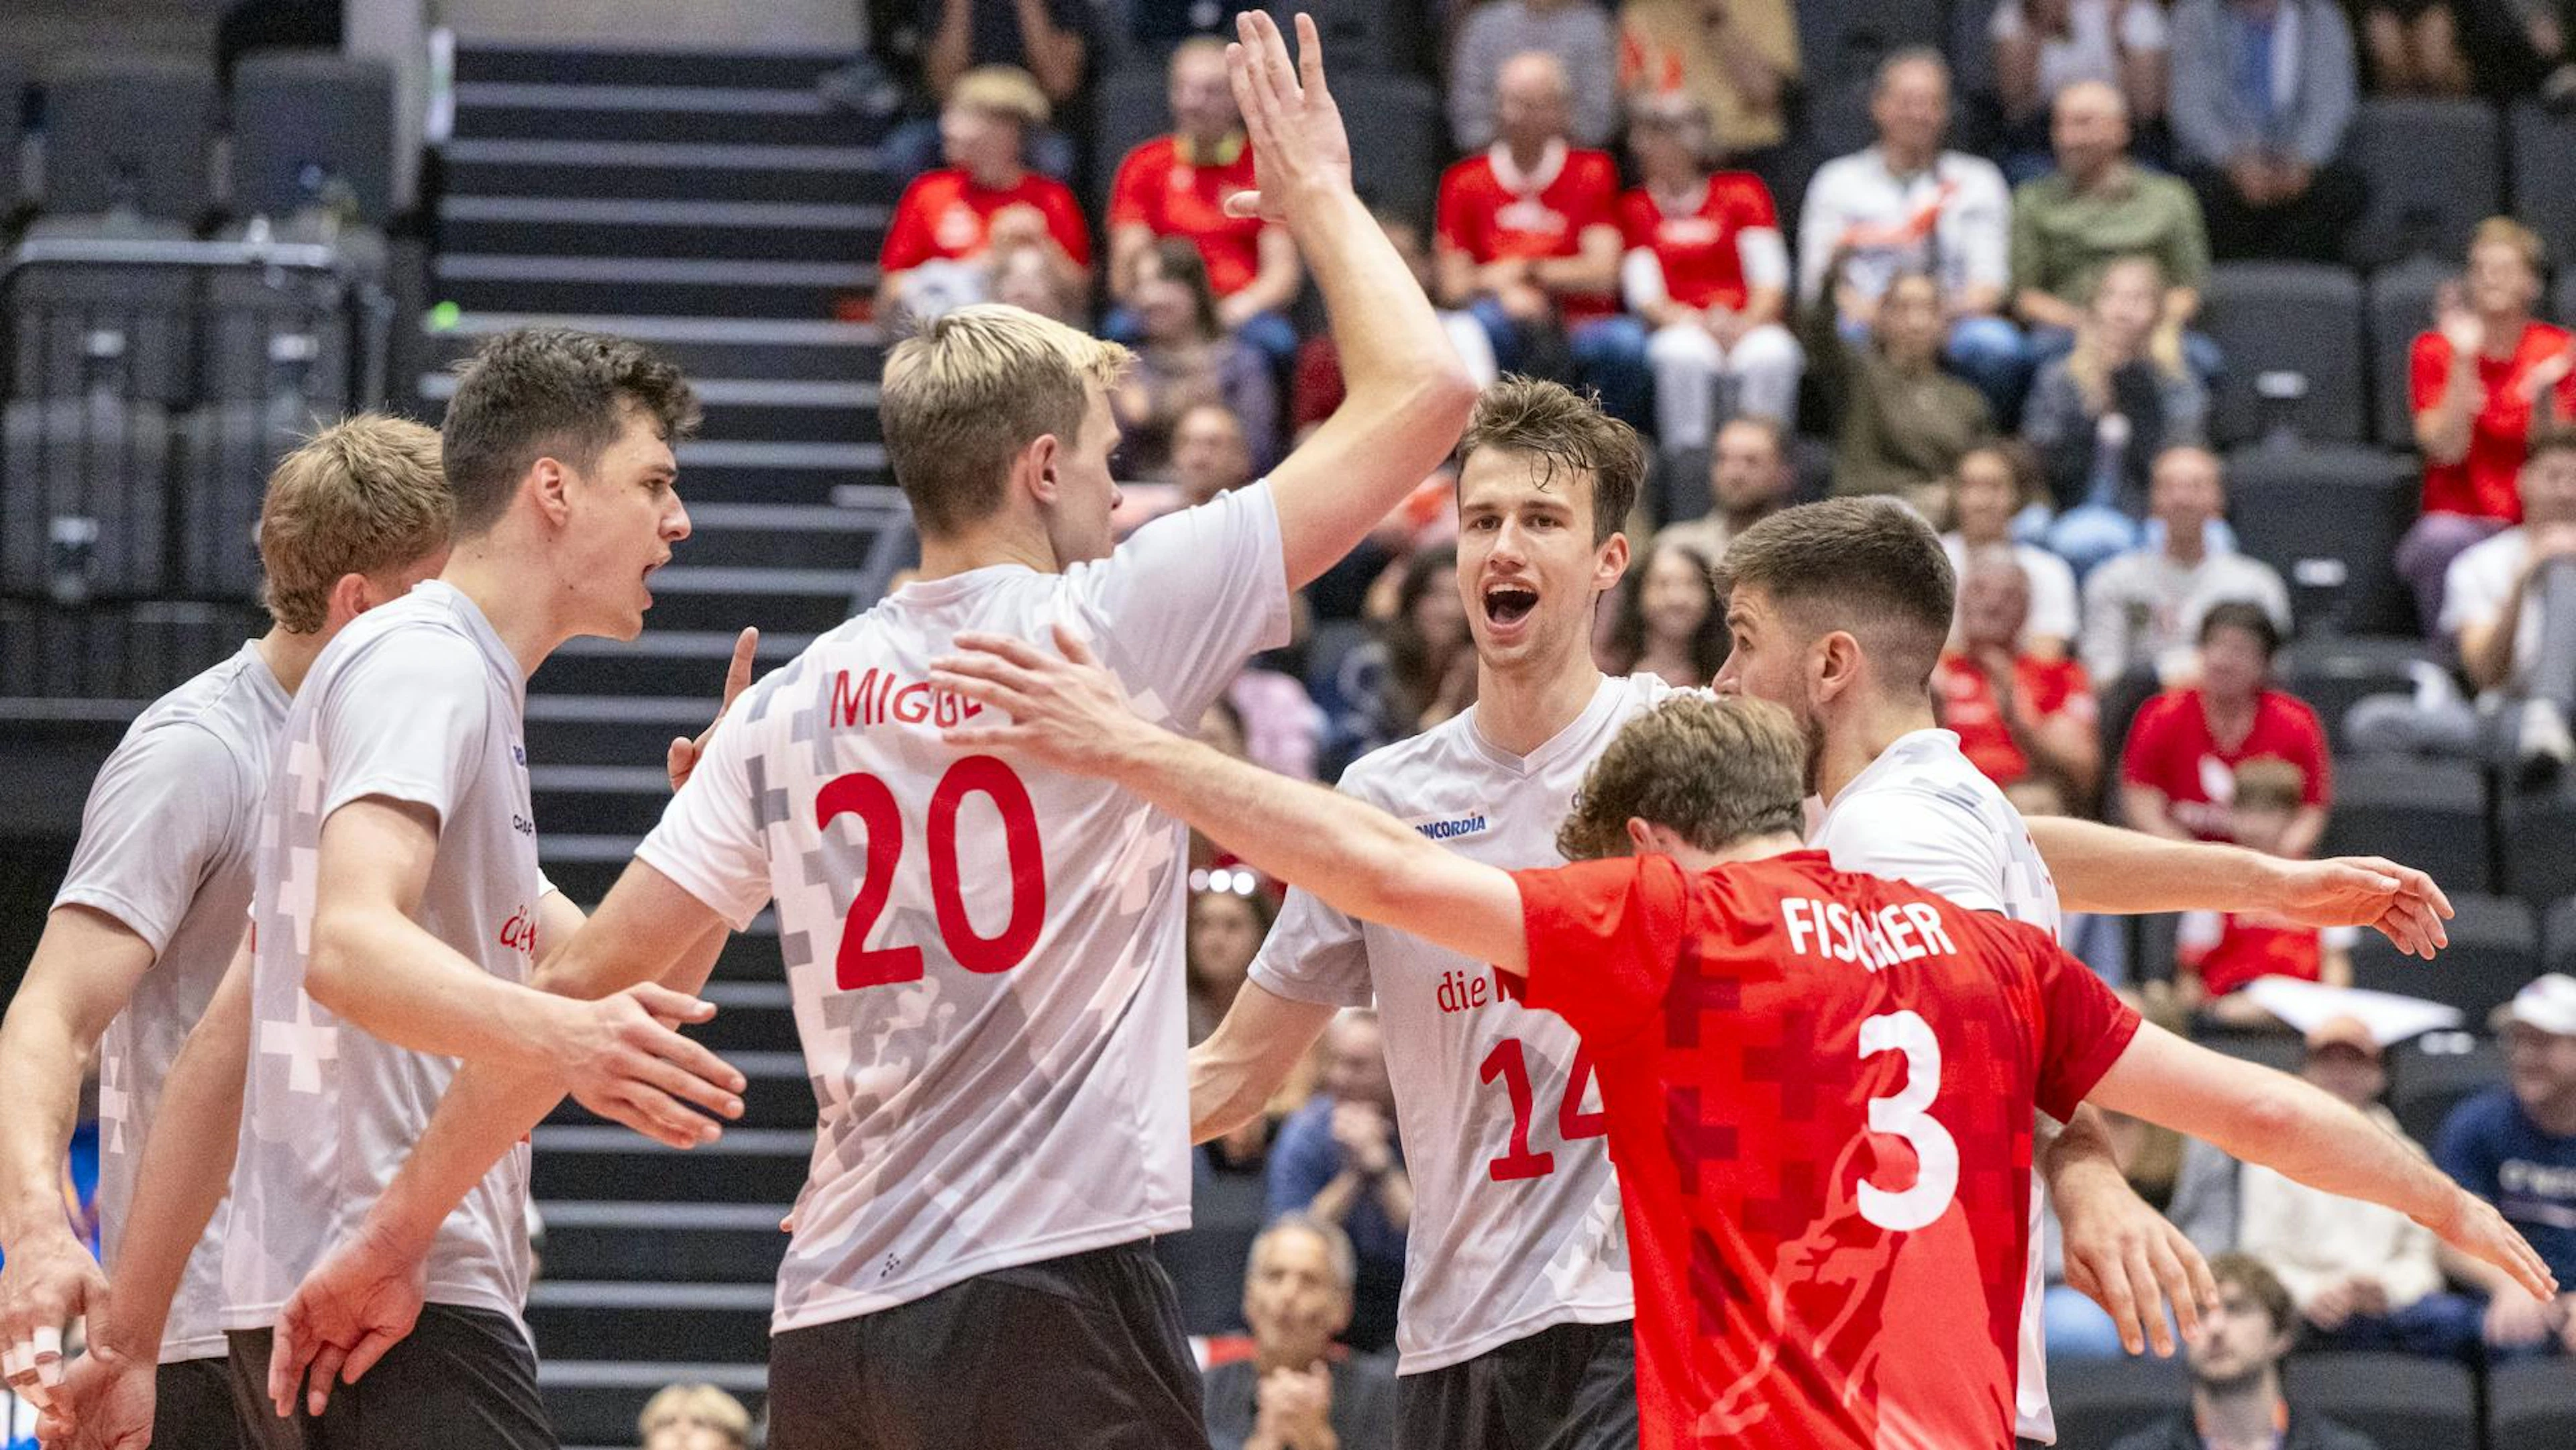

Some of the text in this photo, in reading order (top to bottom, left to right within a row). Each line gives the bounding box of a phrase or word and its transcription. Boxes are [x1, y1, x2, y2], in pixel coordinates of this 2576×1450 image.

[816, 754, 1046, 990] 20
[1415, 811, 1486, 839] NCORDIA
[1437, 970, 1487, 1013] die
[1480, 1037, 1609, 1182] 14
[1857, 1009, 1960, 1231] 3
